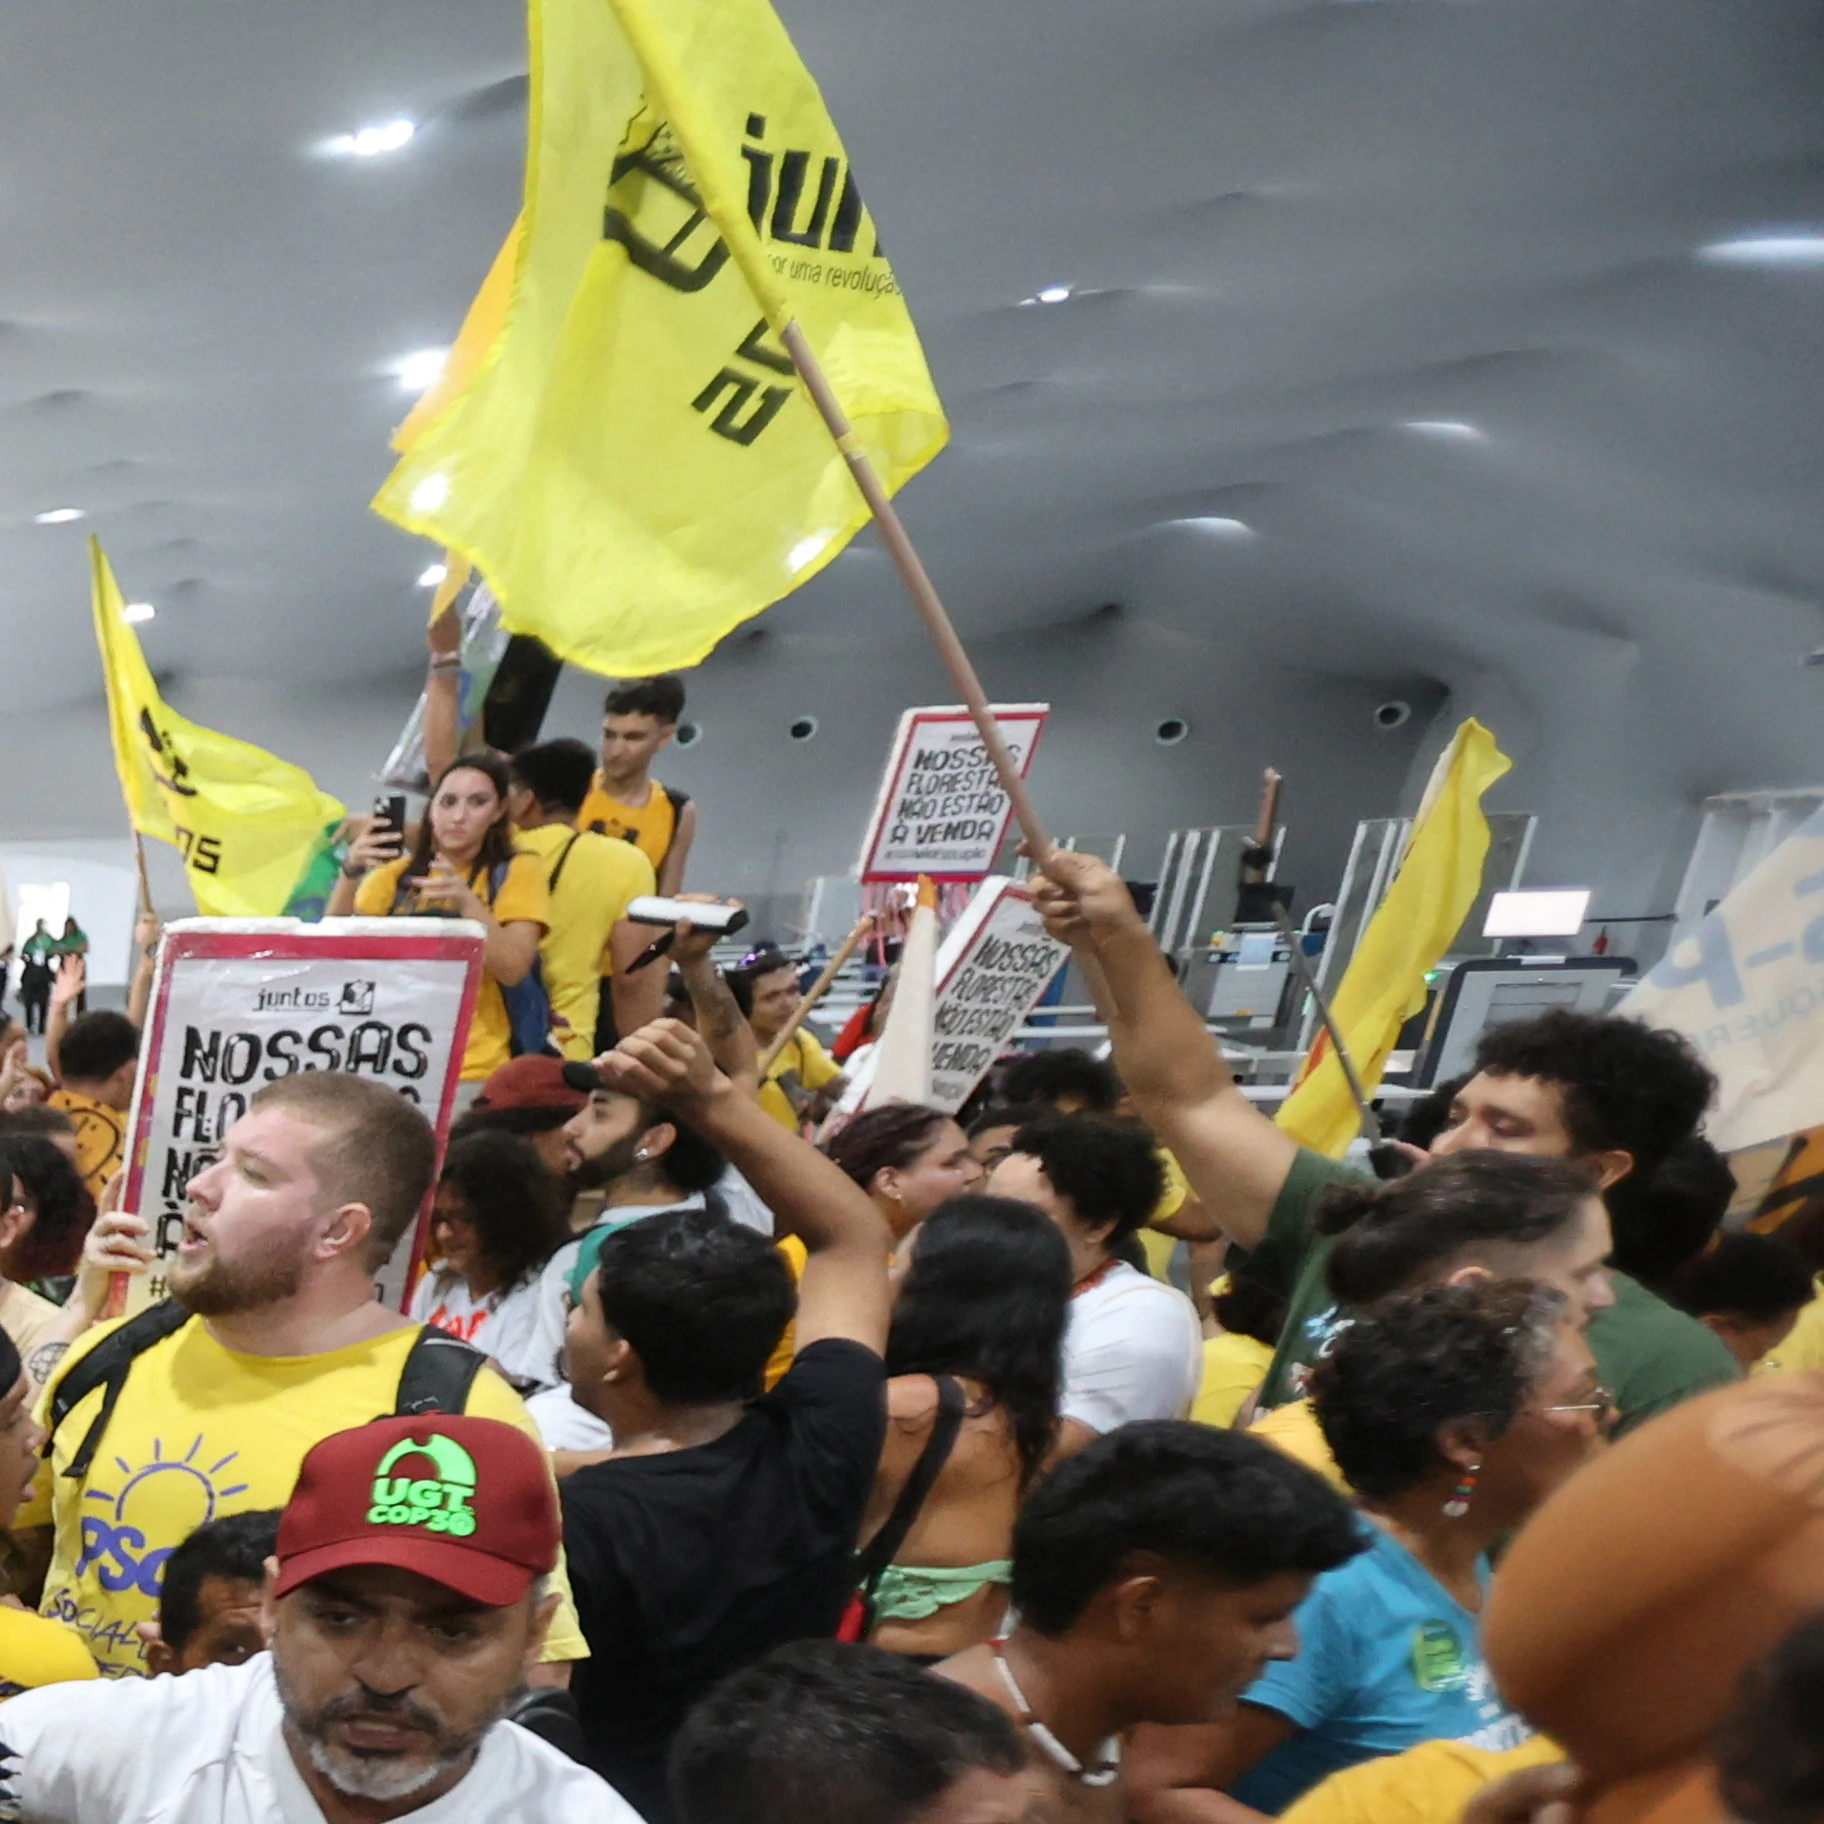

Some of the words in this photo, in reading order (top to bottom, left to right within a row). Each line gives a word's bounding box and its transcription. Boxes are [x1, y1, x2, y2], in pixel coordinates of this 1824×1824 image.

[789, 259, 821, 284] uma
[913, 744, 1022, 771] NOSSS
[906, 769, 1002, 797] FLORESTA
[915, 819, 995, 846] VENDA
[253, 985, 331, 1012] juntos
[179, 1020, 433, 1085] NOSSAS
[372, 1477, 475, 1512] UGT
[367, 1504, 477, 1537] COP30
